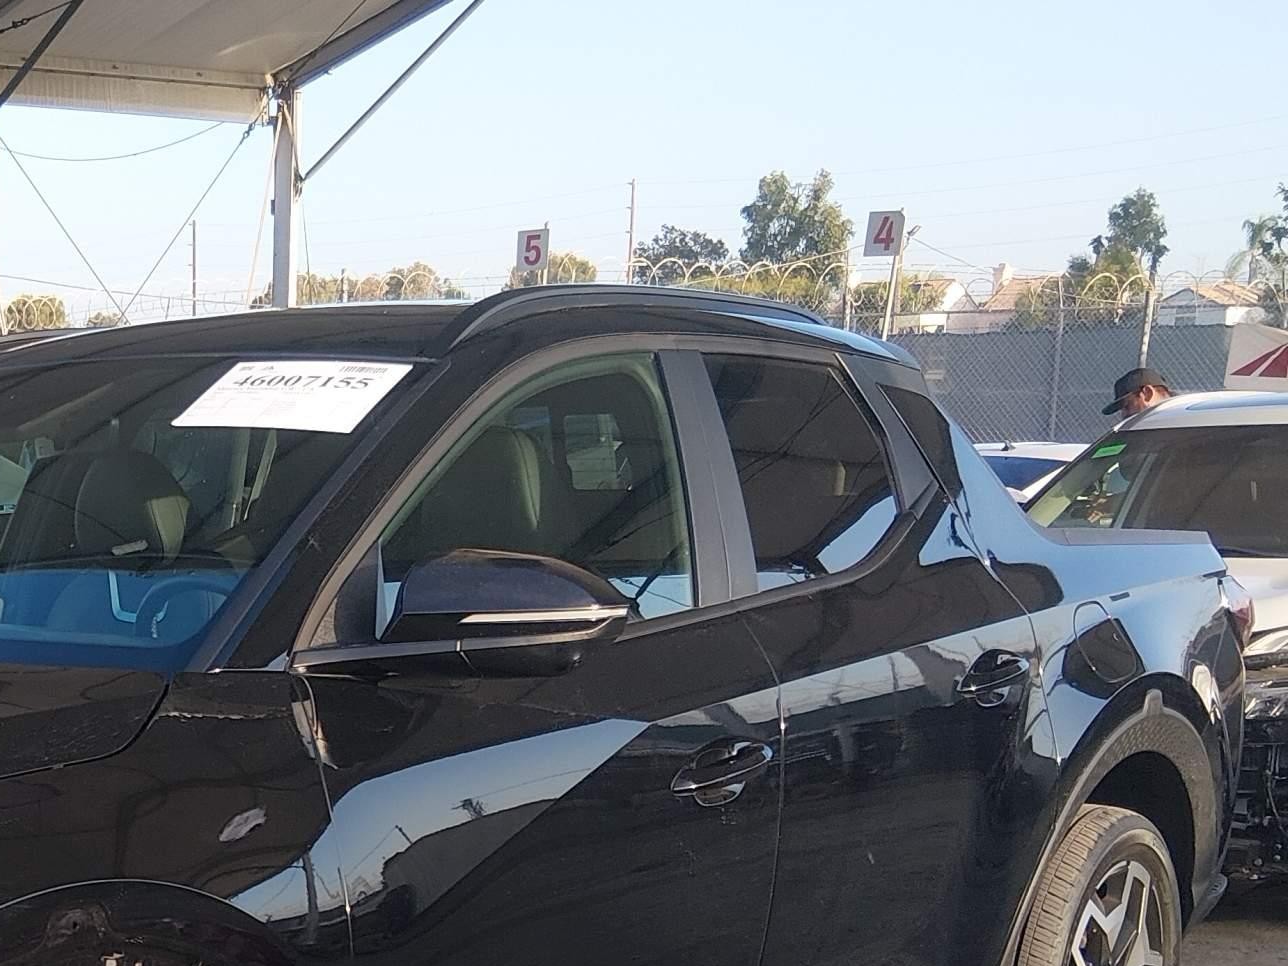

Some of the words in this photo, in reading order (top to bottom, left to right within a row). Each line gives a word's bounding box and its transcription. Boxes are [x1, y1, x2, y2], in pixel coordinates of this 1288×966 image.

[873, 215, 894, 251] 4
[523, 234, 541, 266] 5
[232, 374, 376, 390] 46007155
